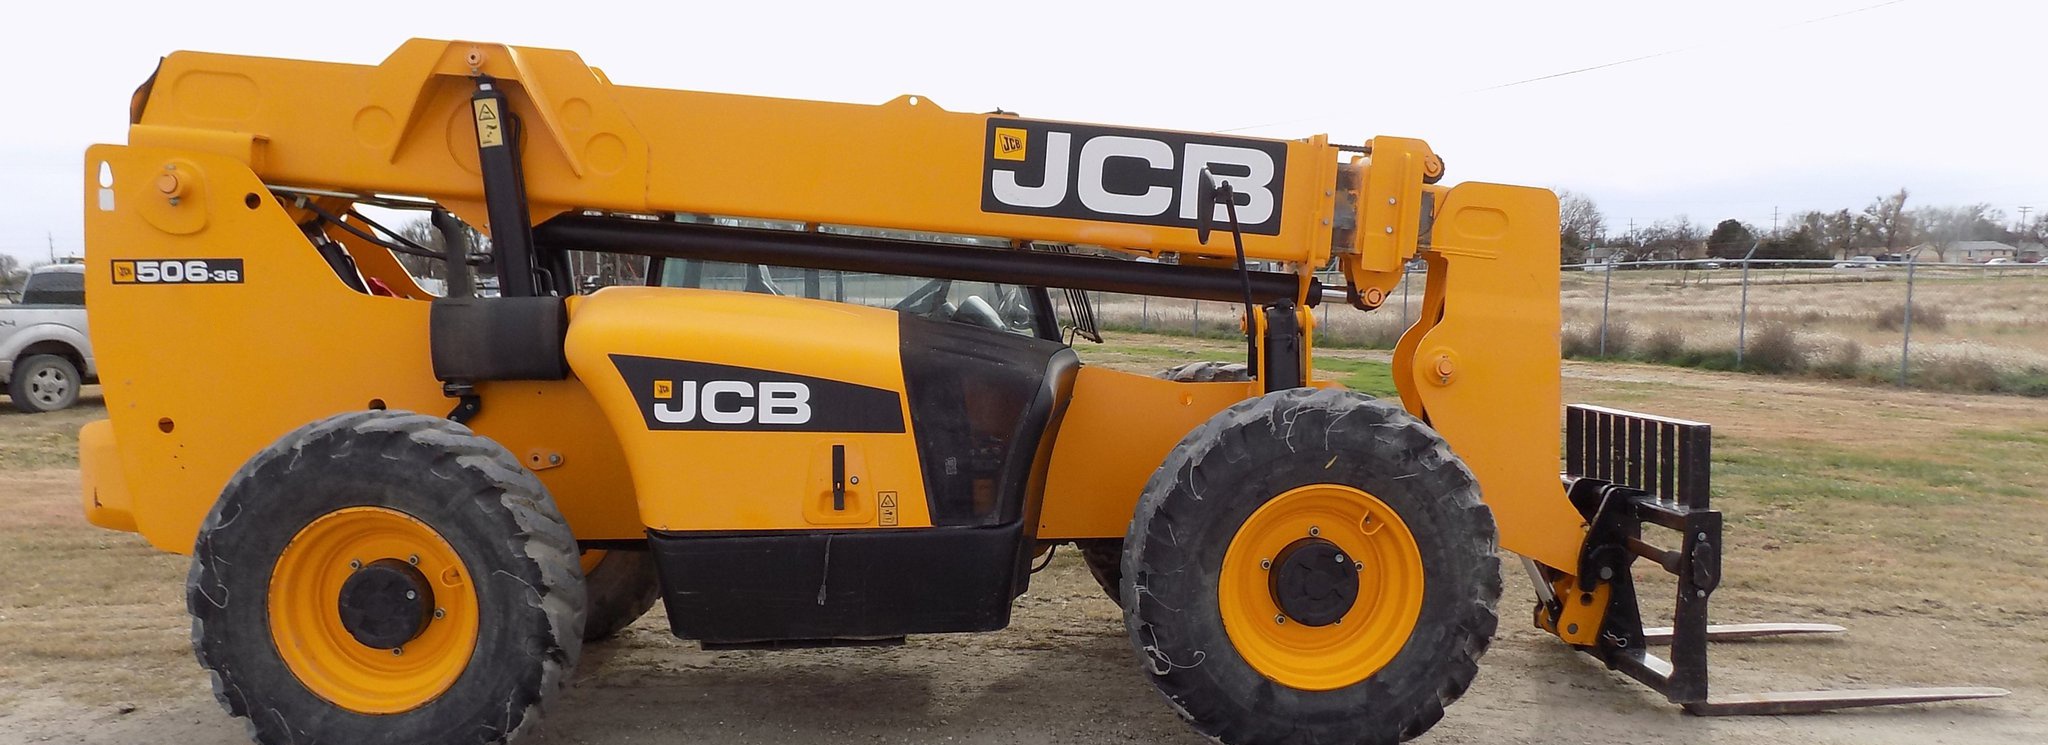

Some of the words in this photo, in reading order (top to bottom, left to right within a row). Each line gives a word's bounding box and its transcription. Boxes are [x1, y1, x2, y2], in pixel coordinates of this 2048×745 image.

[1003, 136, 1021, 151] JCB
[991, 131, 1275, 225] JCB
[136, 260, 239, 283] 506-36
[653, 380, 812, 425] JCB
